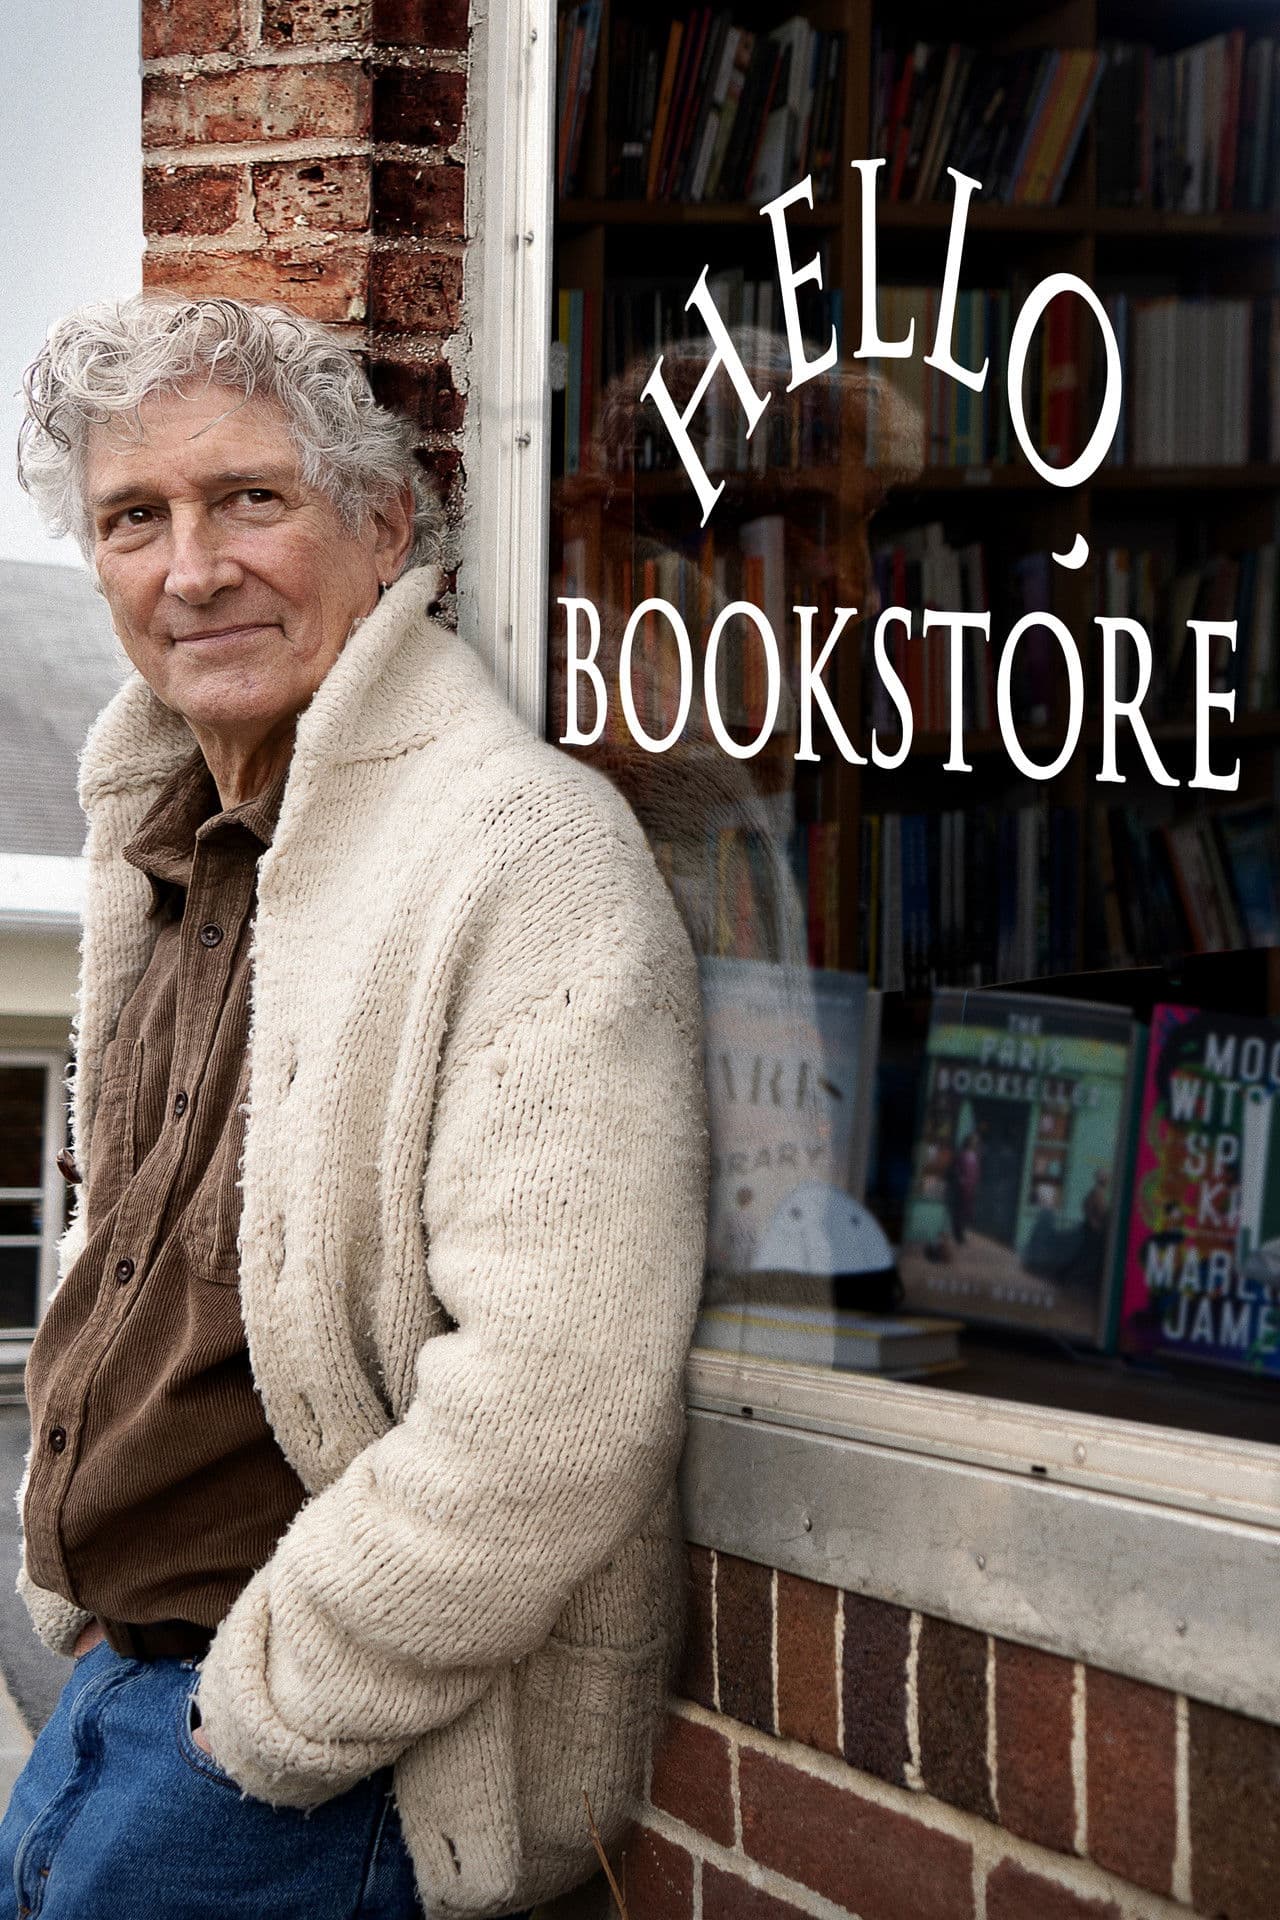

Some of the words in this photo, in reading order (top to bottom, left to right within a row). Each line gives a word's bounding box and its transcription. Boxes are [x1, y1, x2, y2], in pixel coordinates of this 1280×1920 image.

[557, 597, 1240, 791] BOOKSTORE
[1008, 1013, 1043, 1036] THE
[981, 1034, 1064, 1074] PARIS
[1169, 1078, 1264, 1127] WIT
